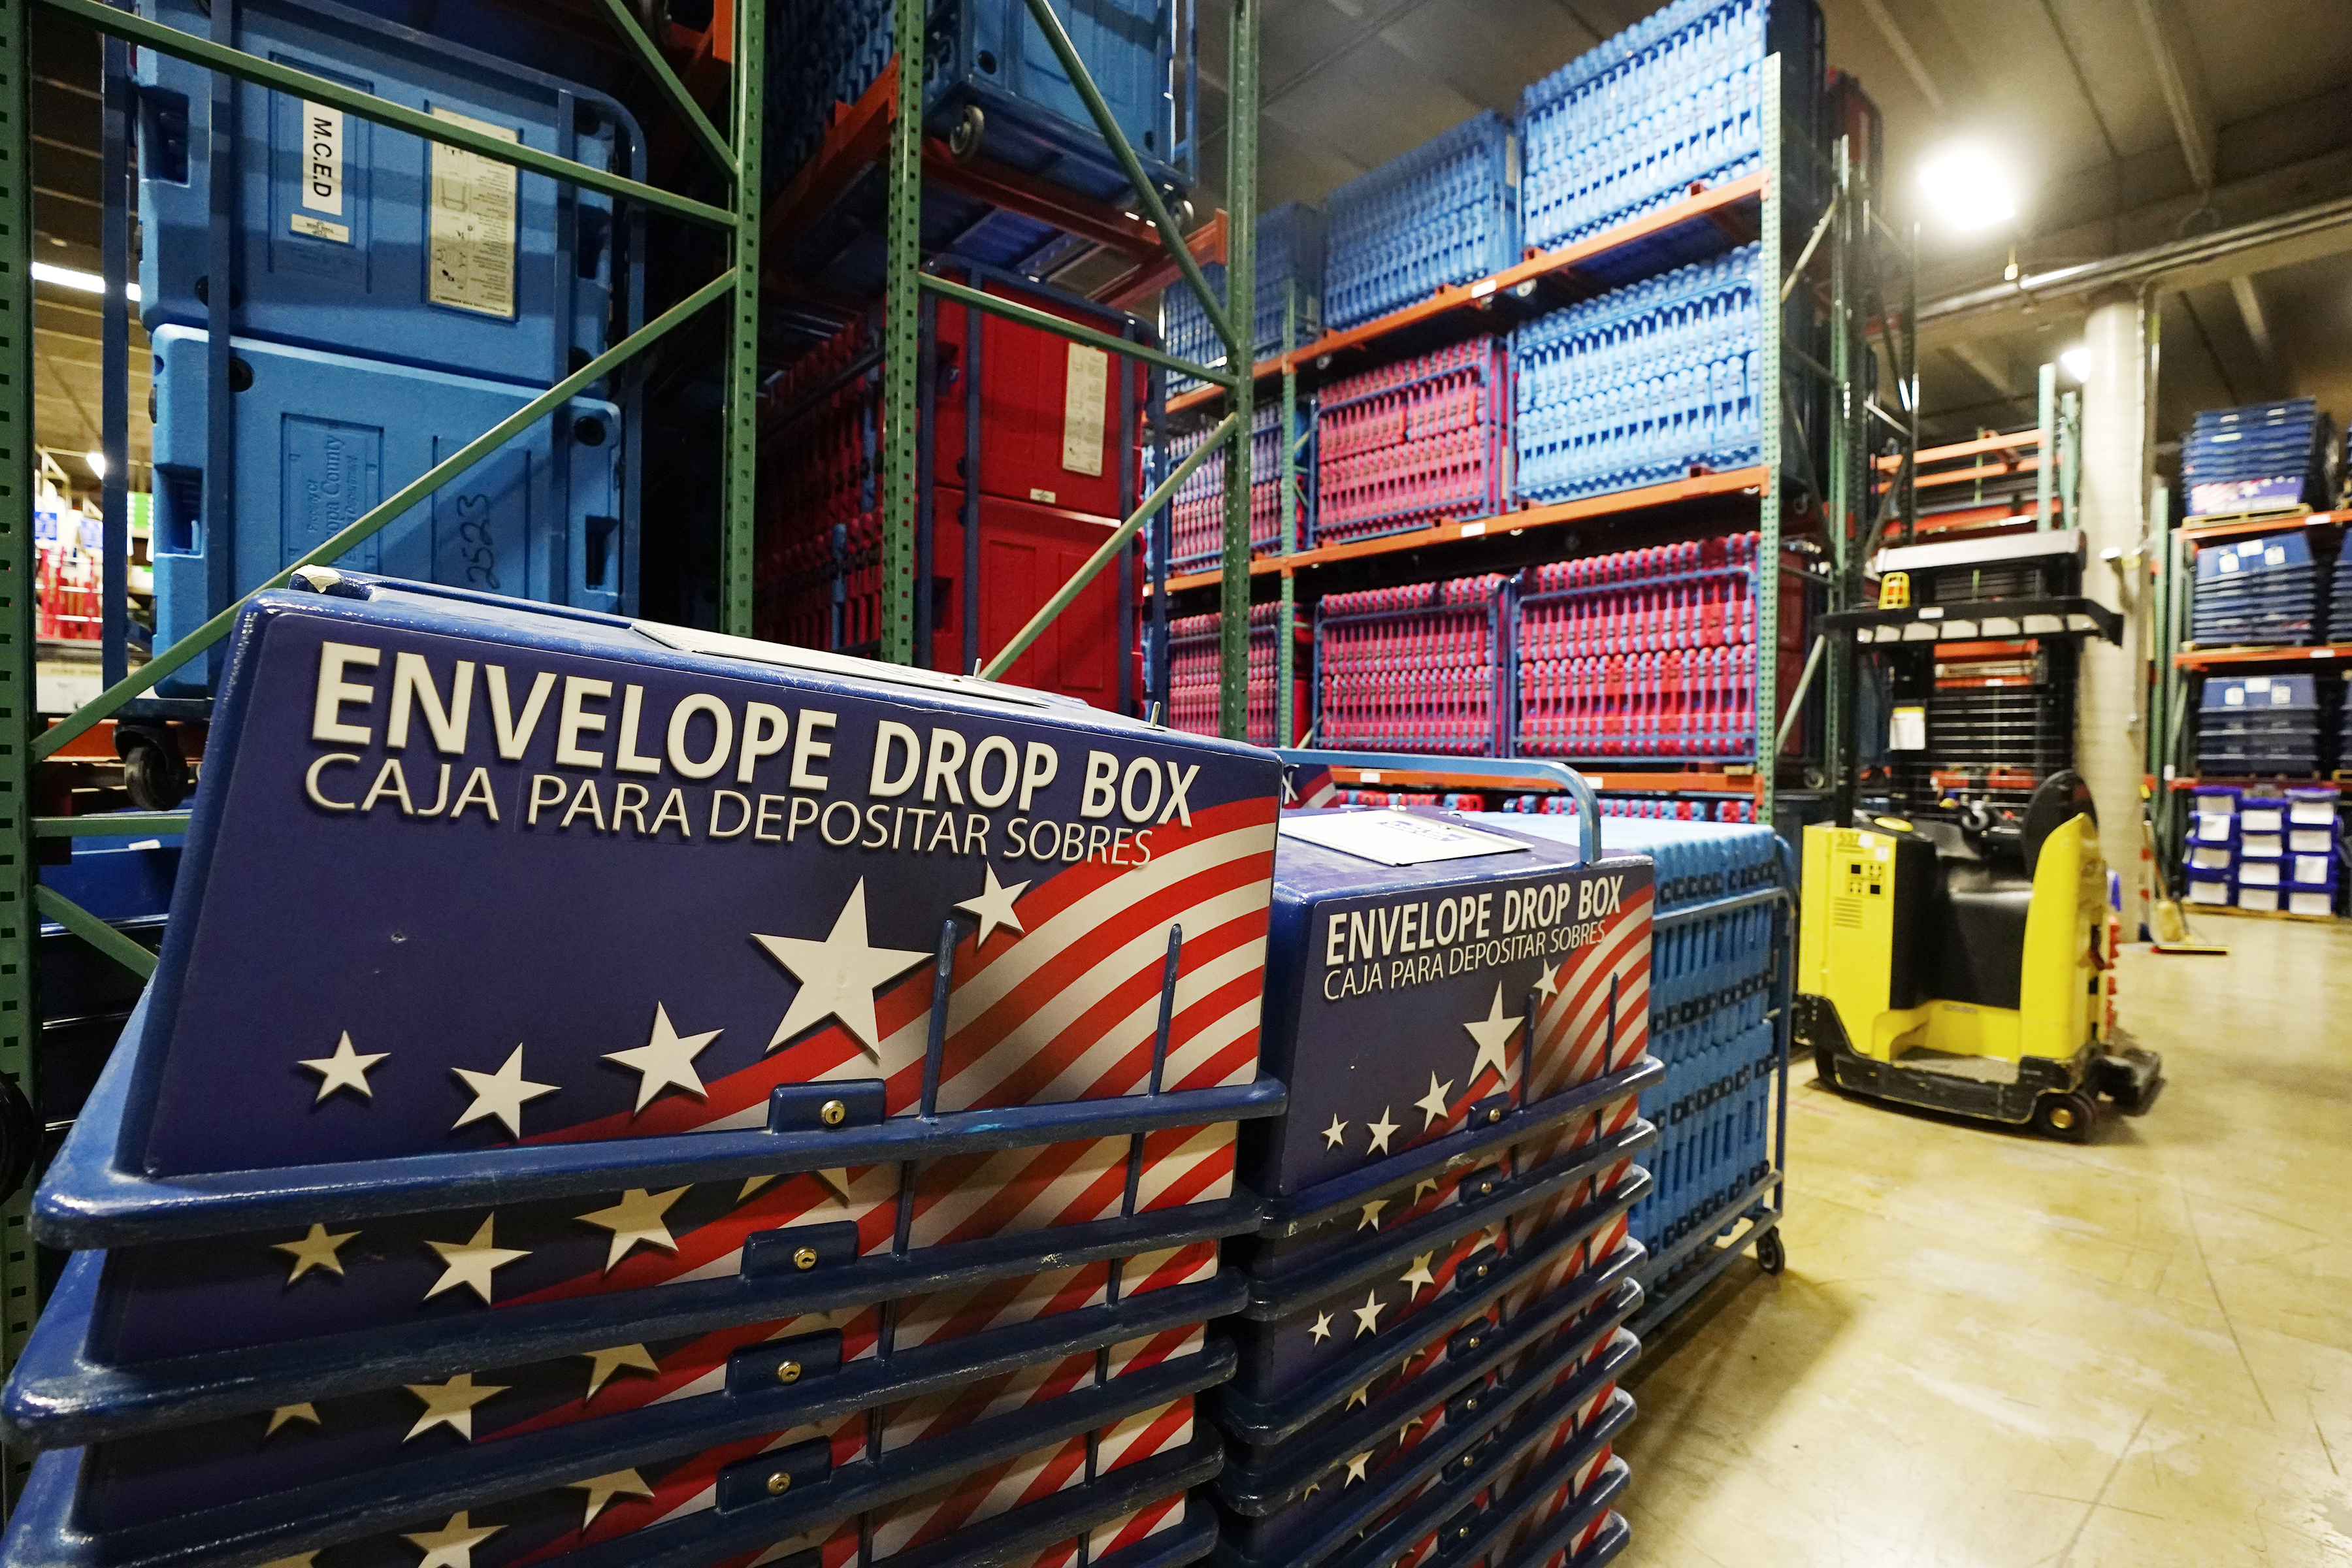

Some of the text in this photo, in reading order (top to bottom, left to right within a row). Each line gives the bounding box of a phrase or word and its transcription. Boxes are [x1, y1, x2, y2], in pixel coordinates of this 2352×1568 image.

[312, 116, 333, 197] M.C.E.D
[320, 434, 345, 498] County
[456, 493, 501, 589] 2523
[312, 641, 838, 791] ENVELOPE
[869, 720, 1058, 812] DROP
[1080, 750, 1201, 828] BOX
[306, 753, 1153, 867] CAJA PARA DEPOSITAR SOBRES
[1324, 920, 1605, 1001] CAJA PARA DEPOSITAR SOBRES
[1326, 875, 1624, 966] ENVELOPE DROP BOX
